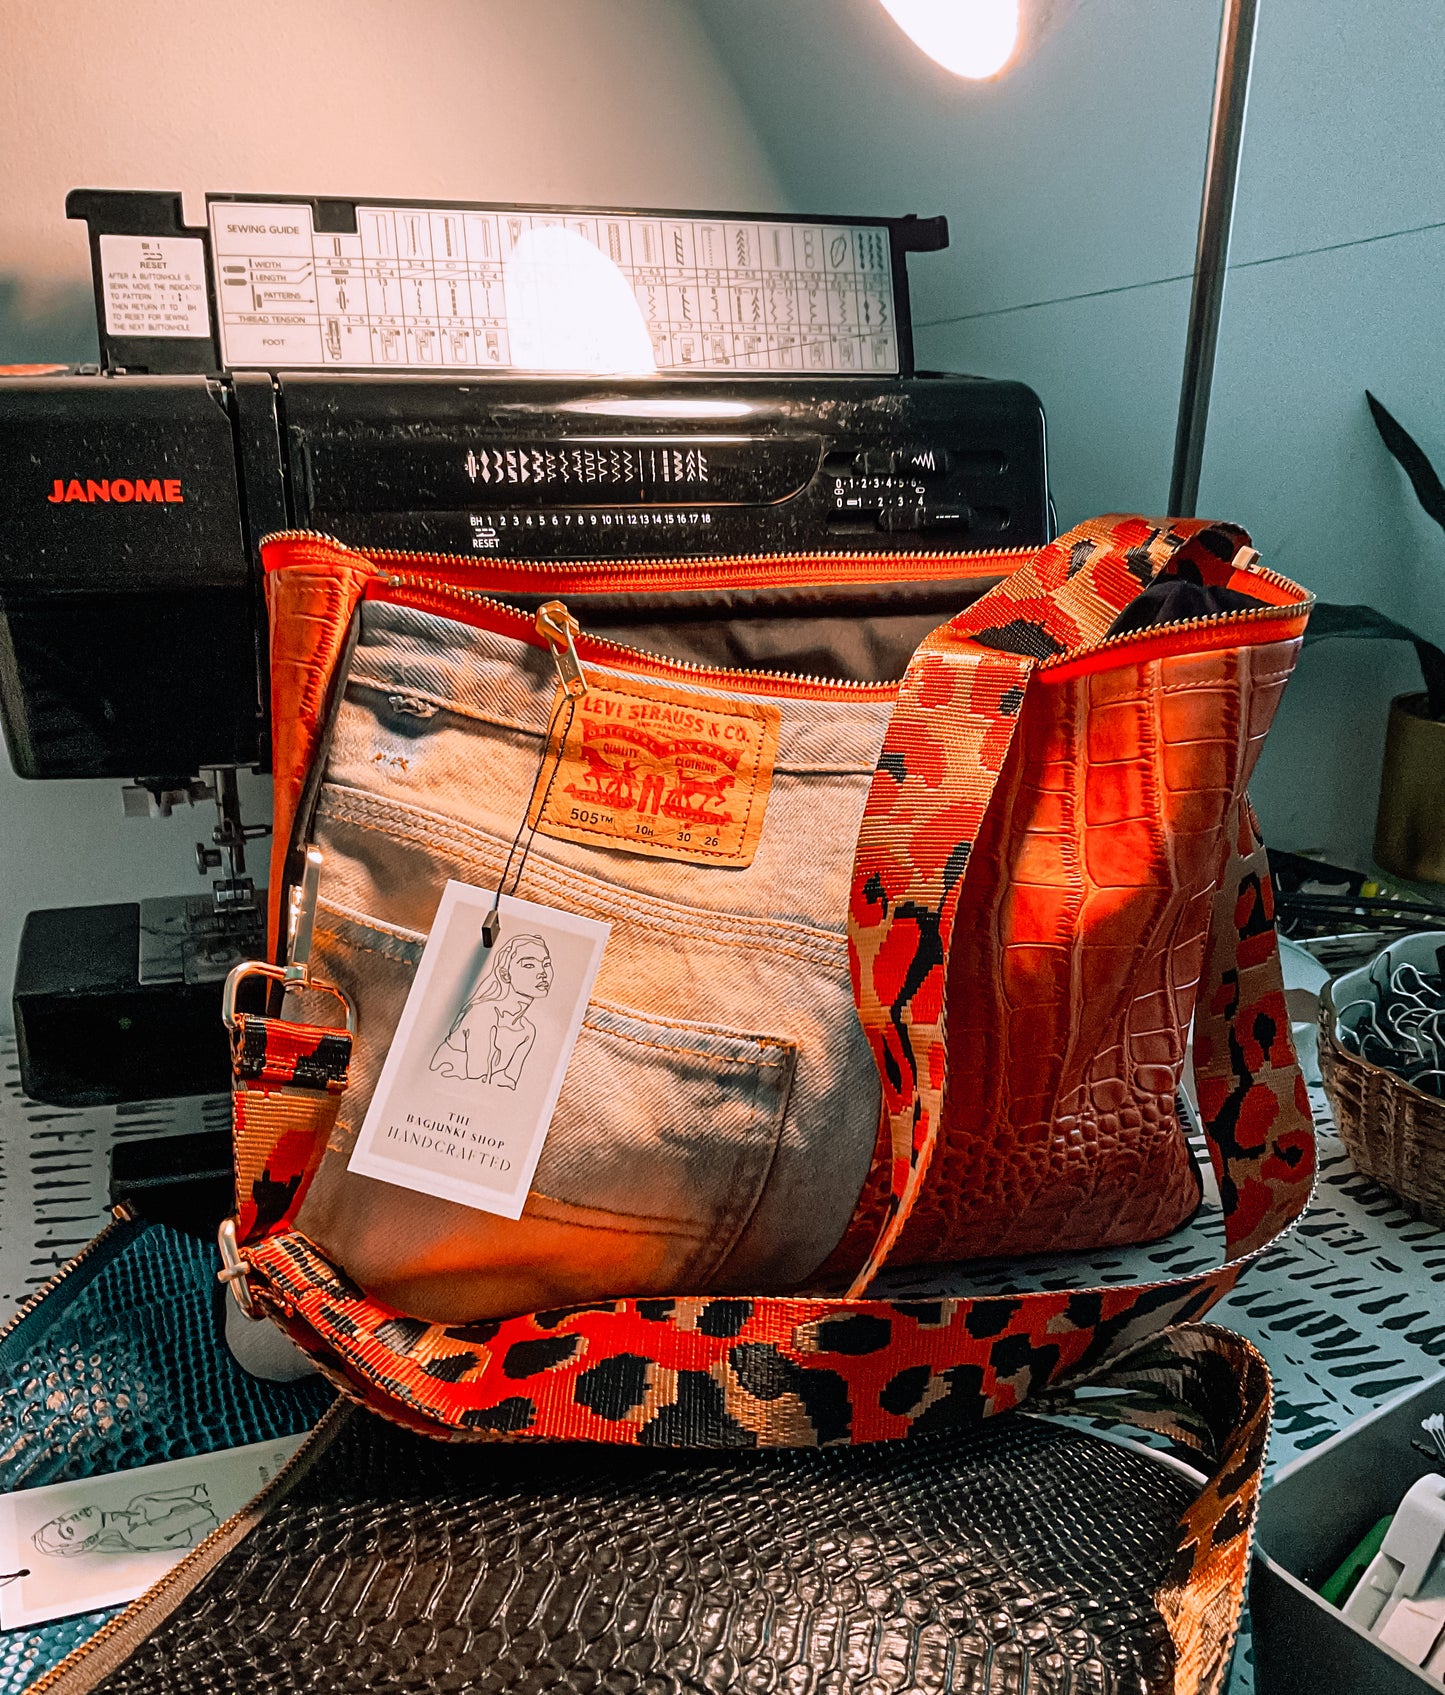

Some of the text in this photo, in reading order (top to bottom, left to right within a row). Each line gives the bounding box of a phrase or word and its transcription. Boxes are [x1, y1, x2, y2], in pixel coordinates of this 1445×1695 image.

[227, 224, 300, 235] SEWING GUIDE
[140, 261, 167, 269] RESET
[254, 261, 281, 269] WIDTH
[123, 293, 152, 301] PATTERN
[263, 291, 302, 300] PATTERNS
[238, 315, 306, 325] THREAD TENSION
[262, 338, 285, 347] FOOT
[836, 478, 842, 488] 0
[849, 478, 854, 489] 1
[861, 478, 867, 489] 2
[873, 478, 879, 489] 3
[886, 477, 892, 488] 4
[899, 479, 904, 488] 5
[48, 479, 183, 502] JANOME
[836, 498, 843, 508] 0
[877, 497, 883, 507] 2
[898, 496, 904, 507] 3
[918, 496, 924, 506] 4
[470, 513, 711, 526] BH 1 2 3 4 5 6 7 8 9 10 11 12 13 14 15 16 17 18
[472, 539, 500, 548] RESET
[583, 697, 622, 718] LEVI
[628, 704, 704, 732] STRAUSS
[709, 723, 719, 737] &
[724, 725, 750, 743] CO.
[603, 742, 638, 758] QUALITY
[675, 757, 717, 774] CLOTHING
[677, 832, 691, 842] 30
[705, 836, 718, 846] 26
[471, 1133, 505, 1150] SHOP
[387, 1126, 512, 1172] HANDCRAFTED
